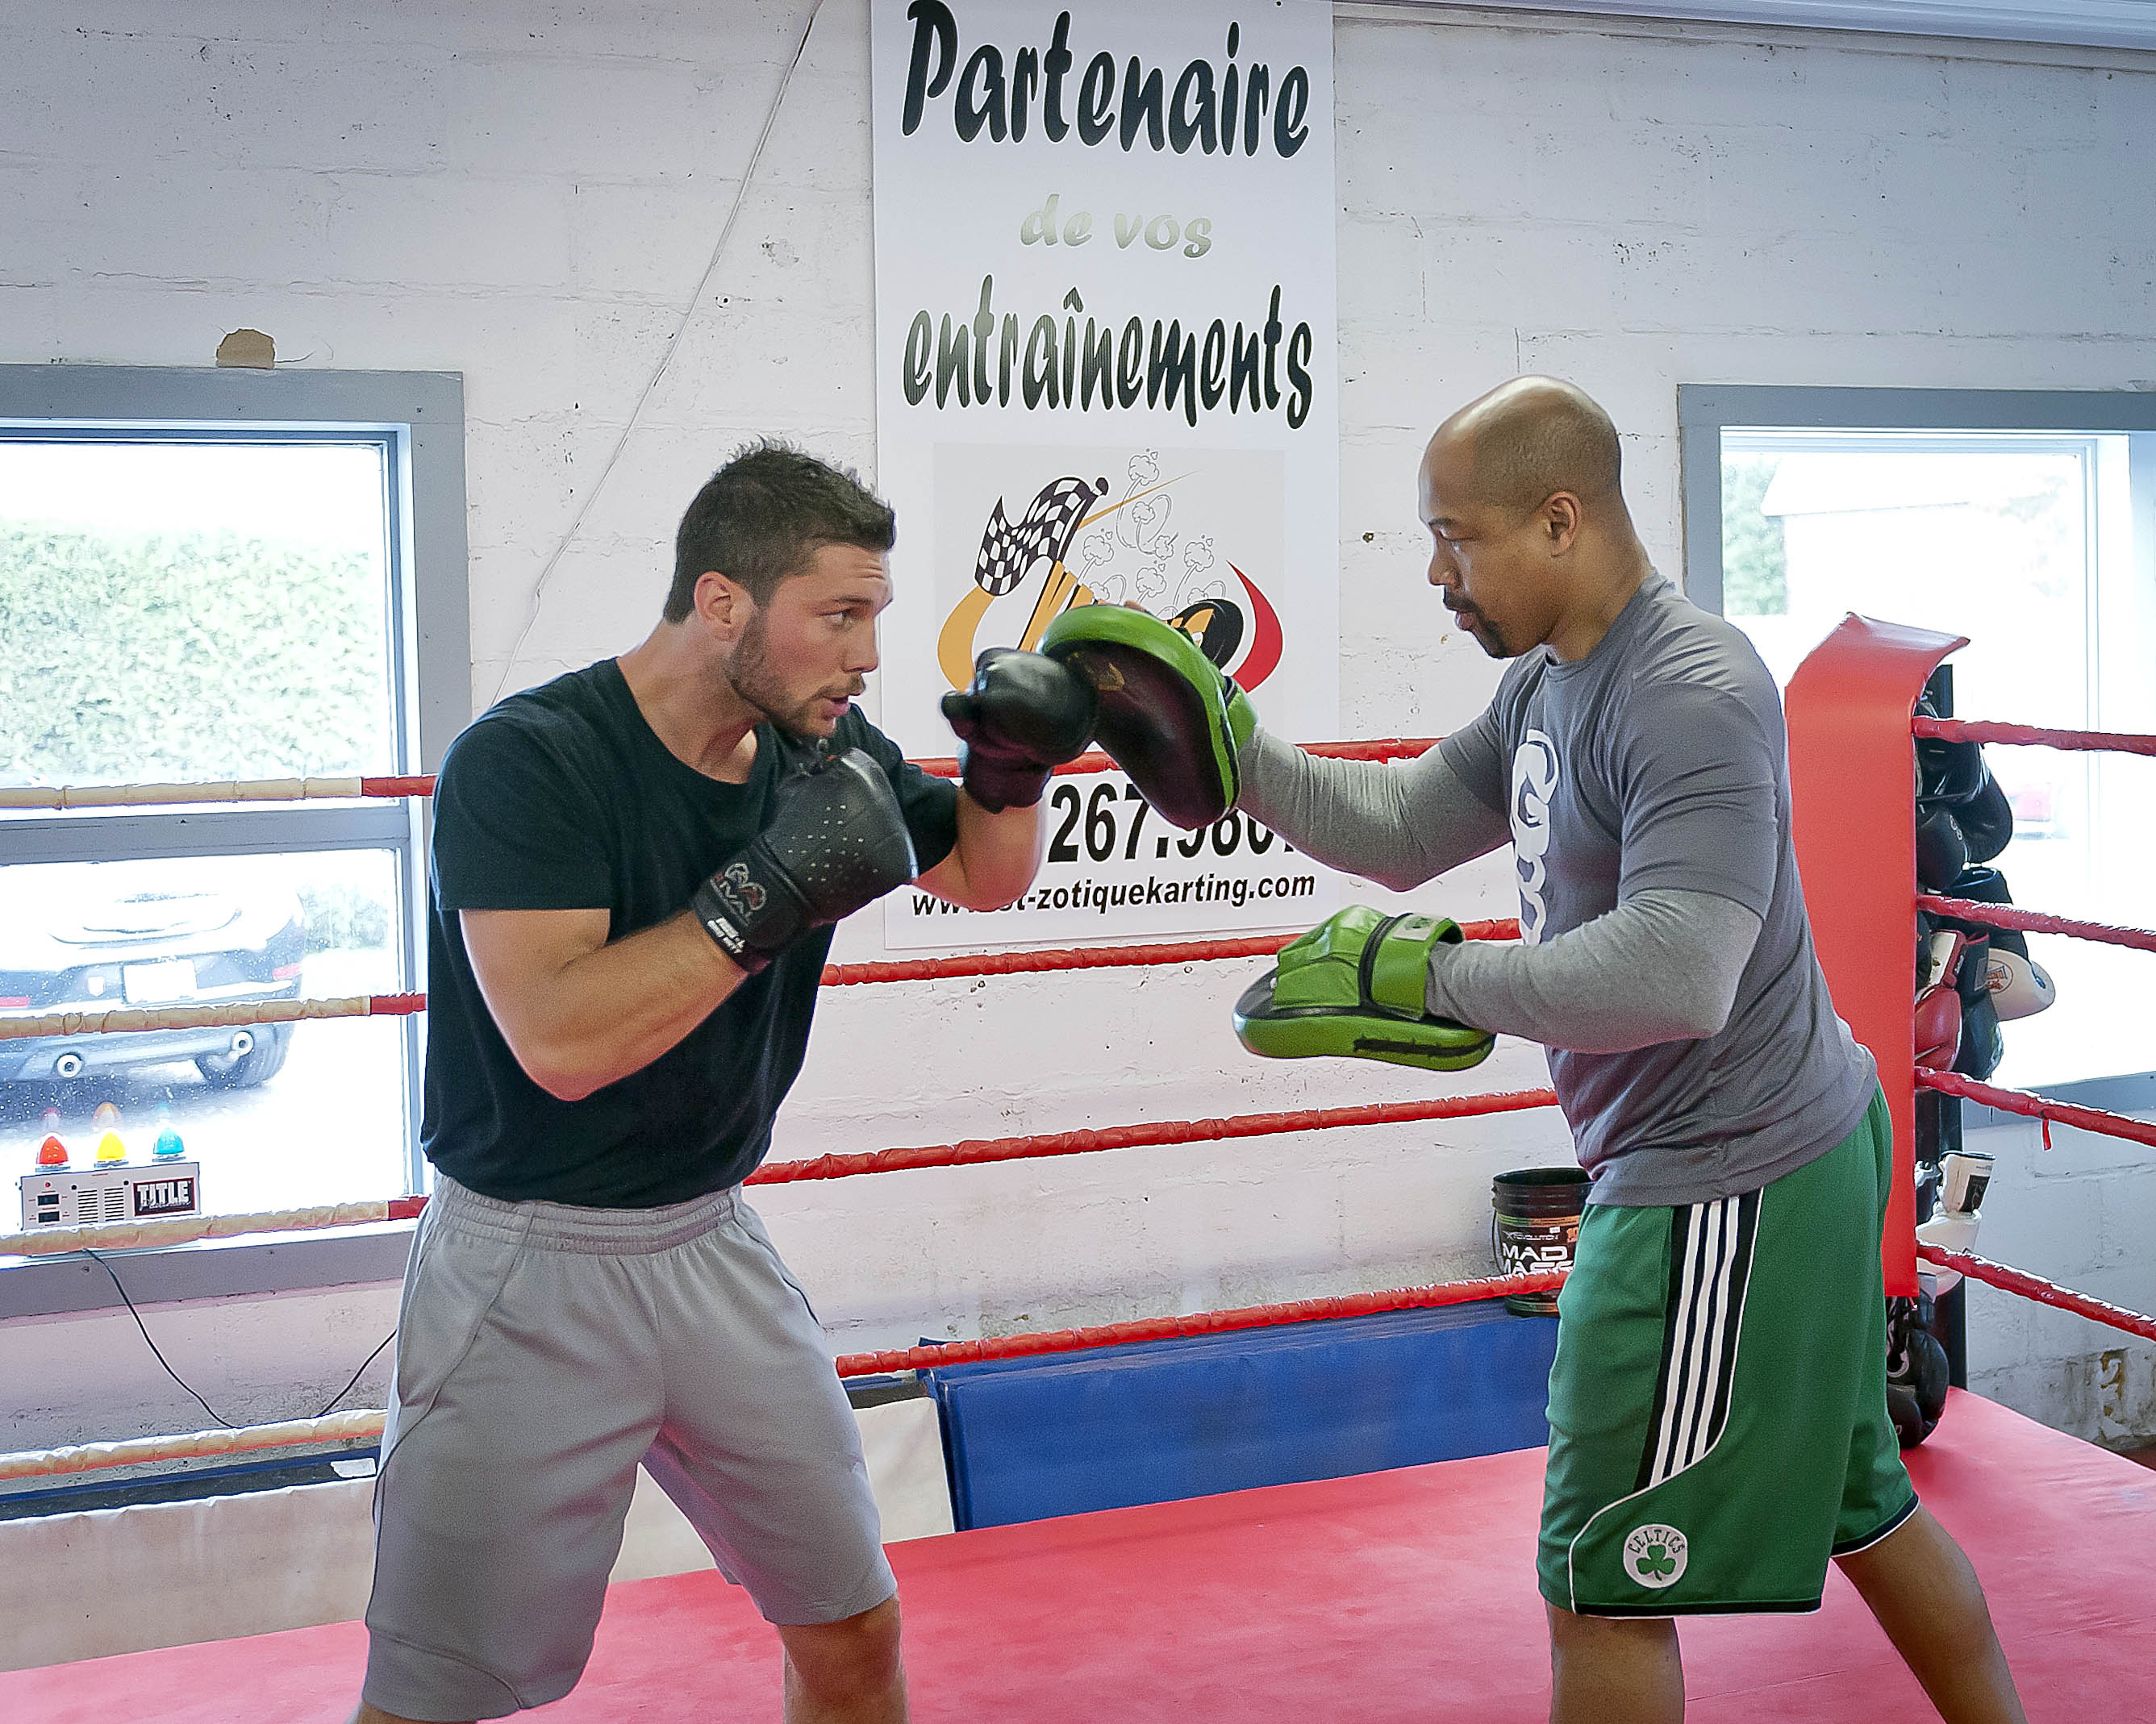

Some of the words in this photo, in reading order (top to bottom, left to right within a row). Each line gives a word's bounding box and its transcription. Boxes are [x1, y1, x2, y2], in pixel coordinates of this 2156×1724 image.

[901, 0, 1310, 159] Partenaire
[1020, 194, 1093, 248] de
[1114, 213, 1212, 258] vos
[902, 274, 1312, 429] entraînements
[137, 1181, 190, 1207] TITLE
[1502, 1243, 1568, 1262] MAD
[1628, 1529, 1686, 1554] CELTICS
